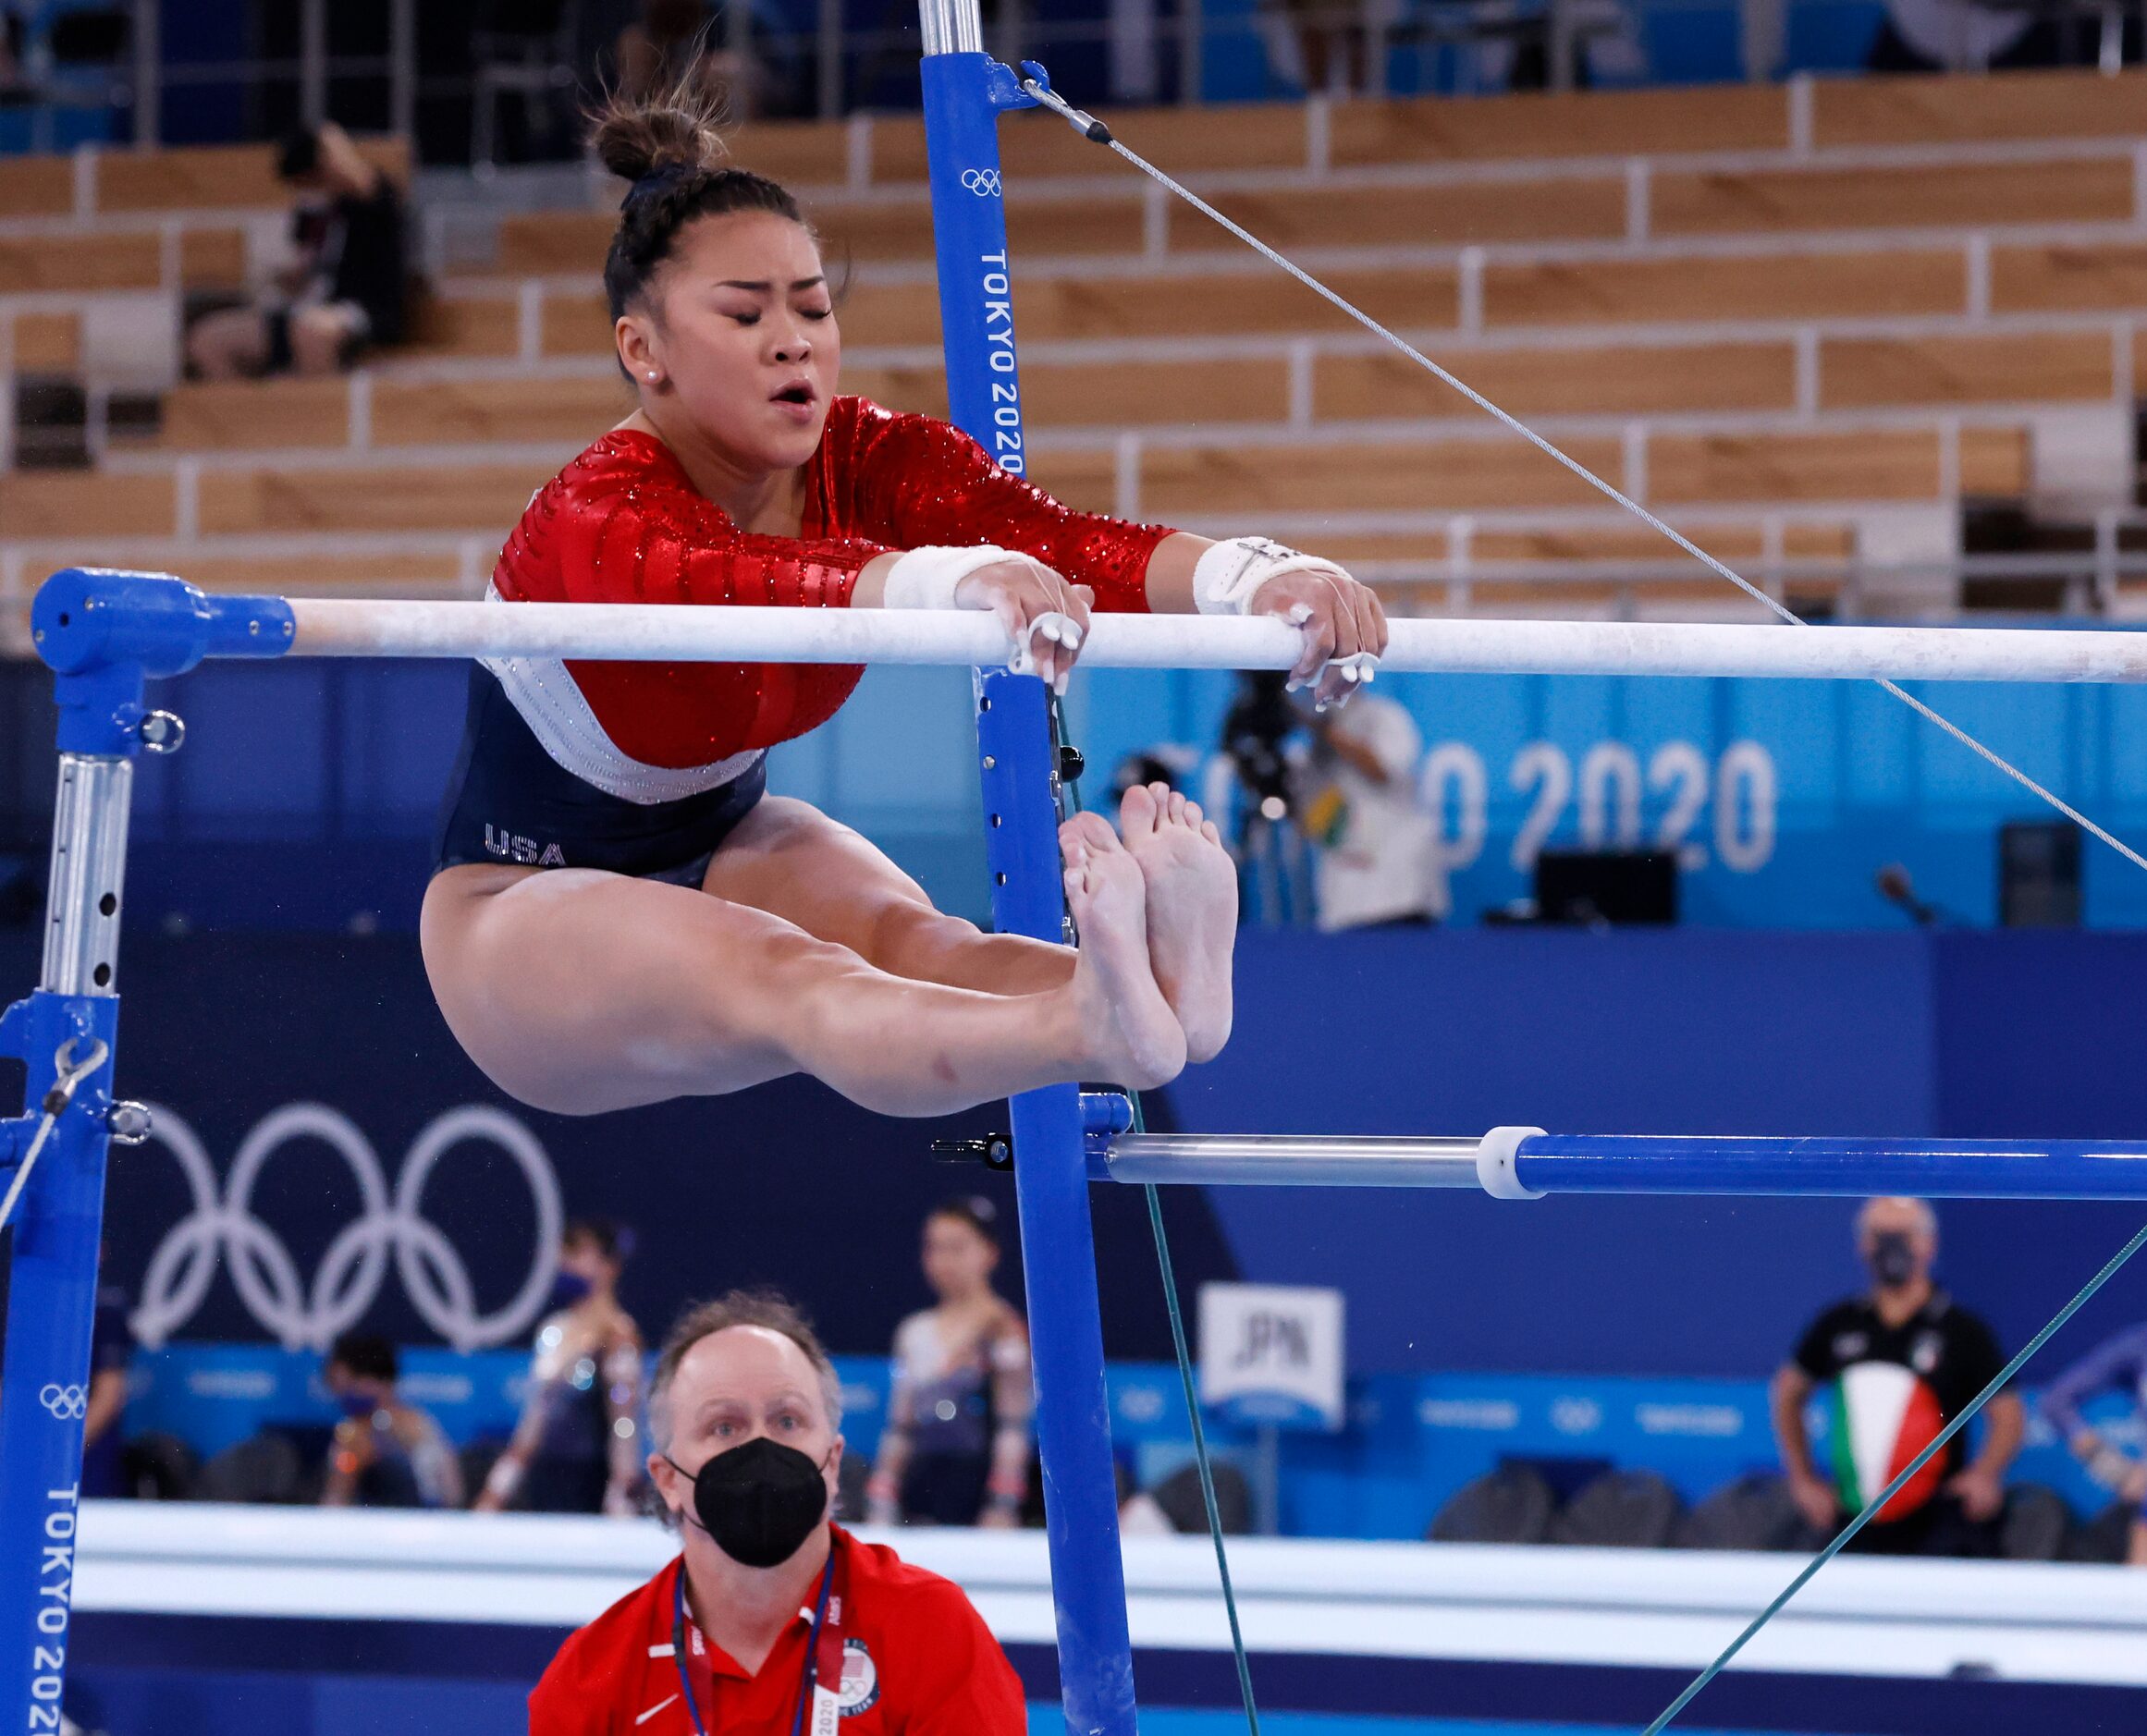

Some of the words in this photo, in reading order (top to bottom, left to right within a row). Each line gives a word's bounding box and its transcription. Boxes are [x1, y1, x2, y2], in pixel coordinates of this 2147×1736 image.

[981, 249, 1015, 373] TOKYO
[991, 383, 1024, 473] 2020
[485, 823, 568, 866] USA
[1509, 741, 1777, 874] 2020
[1233, 1309, 1311, 1370] JPN
[36, 1482, 79, 1634] TOKYO
[29, 1645, 65, 1736] 202
[818, 1699, 834, 1735] 2020
